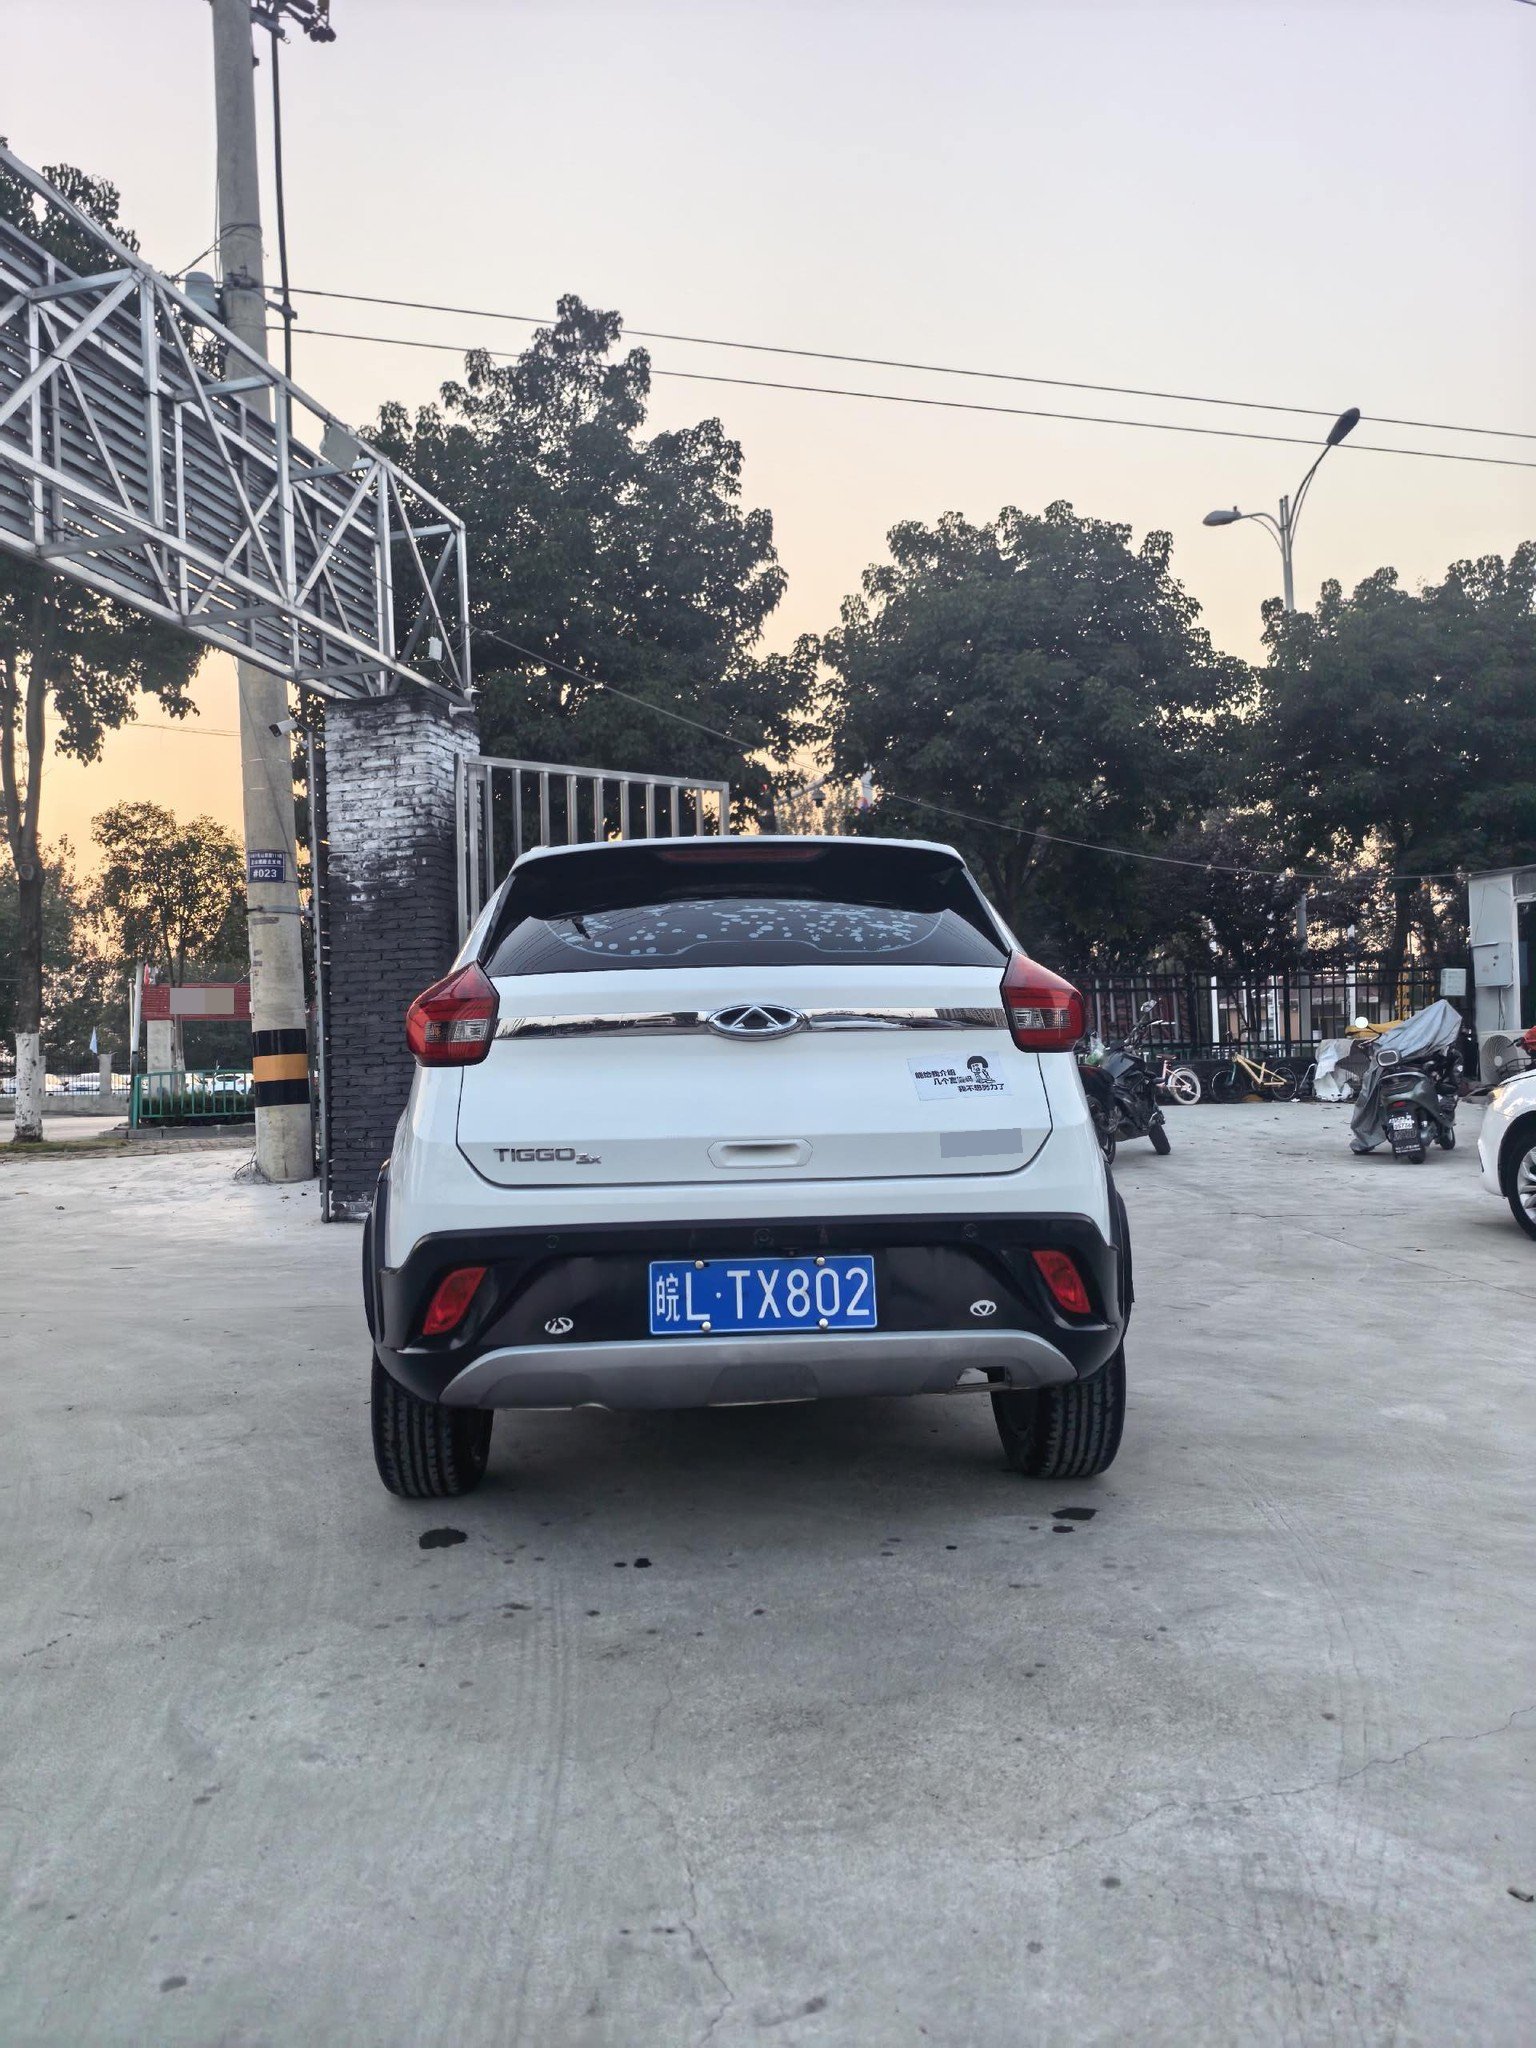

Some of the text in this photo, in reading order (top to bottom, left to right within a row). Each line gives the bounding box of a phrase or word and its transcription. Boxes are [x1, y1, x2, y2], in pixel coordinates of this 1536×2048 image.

[253, 869, 277, 878] #023
[493, 1148, 576, 1163] TIGGO
[655, 1266, 870, 1322] 皖L·TX802
